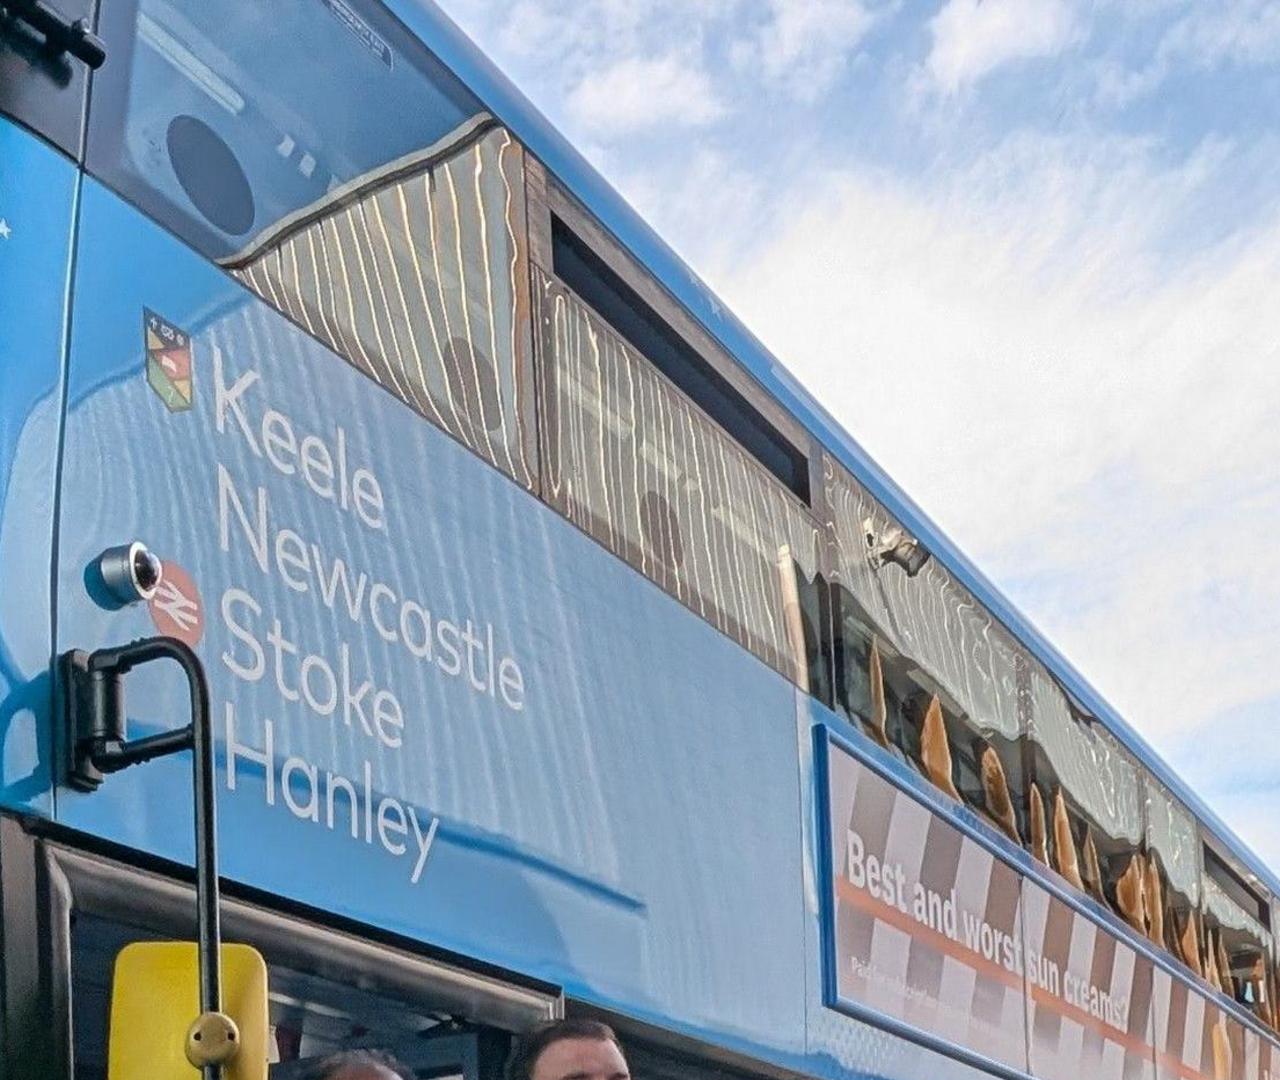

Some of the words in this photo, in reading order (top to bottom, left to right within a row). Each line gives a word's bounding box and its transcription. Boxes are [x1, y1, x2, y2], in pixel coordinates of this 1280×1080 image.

[213, 343, 385, 530] Keele
[218, 462, 526, 712] Newcastle
[221, 586, 405, 750] Stoke
[225, 701, 440, 884] Hanley
[846, 829, 908, 914] Best
[913, 881, 958, 942] and
[963, 909, 1024, 977] worst
[1027, 950, 1060, 997] sun
